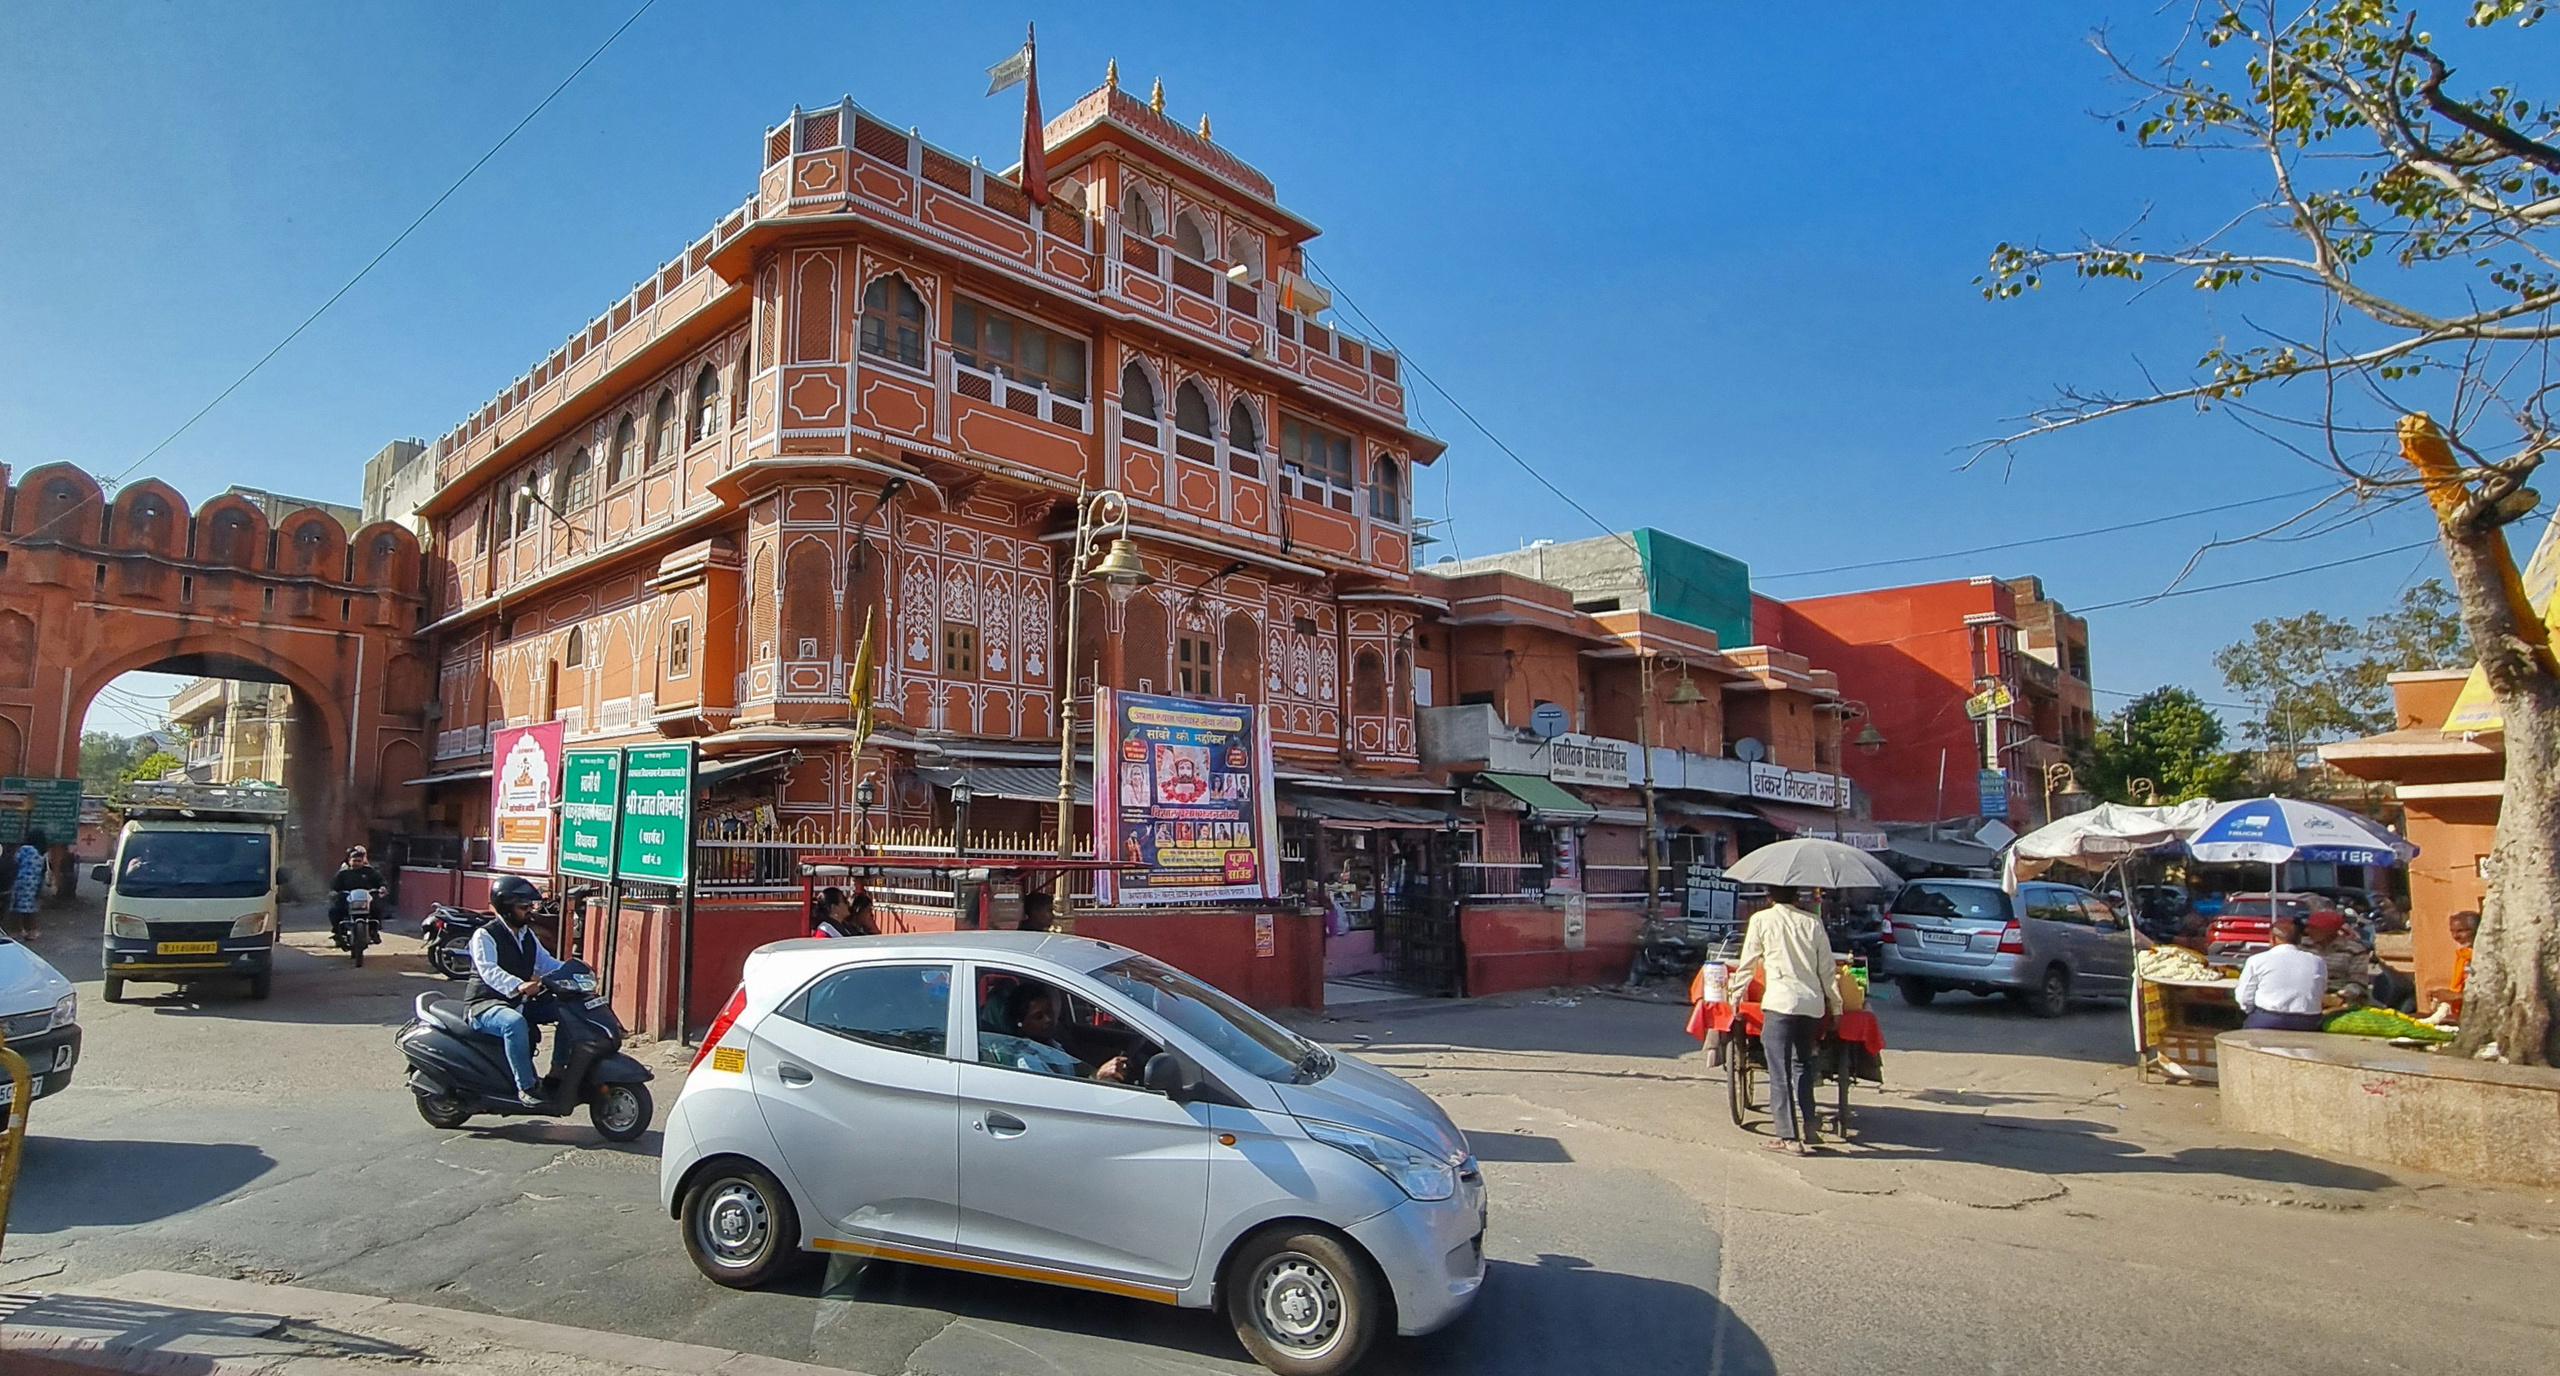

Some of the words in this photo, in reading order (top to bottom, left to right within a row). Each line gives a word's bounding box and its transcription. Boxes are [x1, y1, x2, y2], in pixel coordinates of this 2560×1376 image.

[1754, 768, 1783, 796] शंकर
[1784, 769, 1817, 801] मिष्ठान
[626, 790, 636, 815] श्री
[637, 794, 656, 816] रजत
[656, 789, 685, 820] विश्नोई
[639, 828, 665, 845] (पार्षद)
[2228, 830, 2264, 838] TRUCKS
[1229, 853, 1250, 868] पूजा
